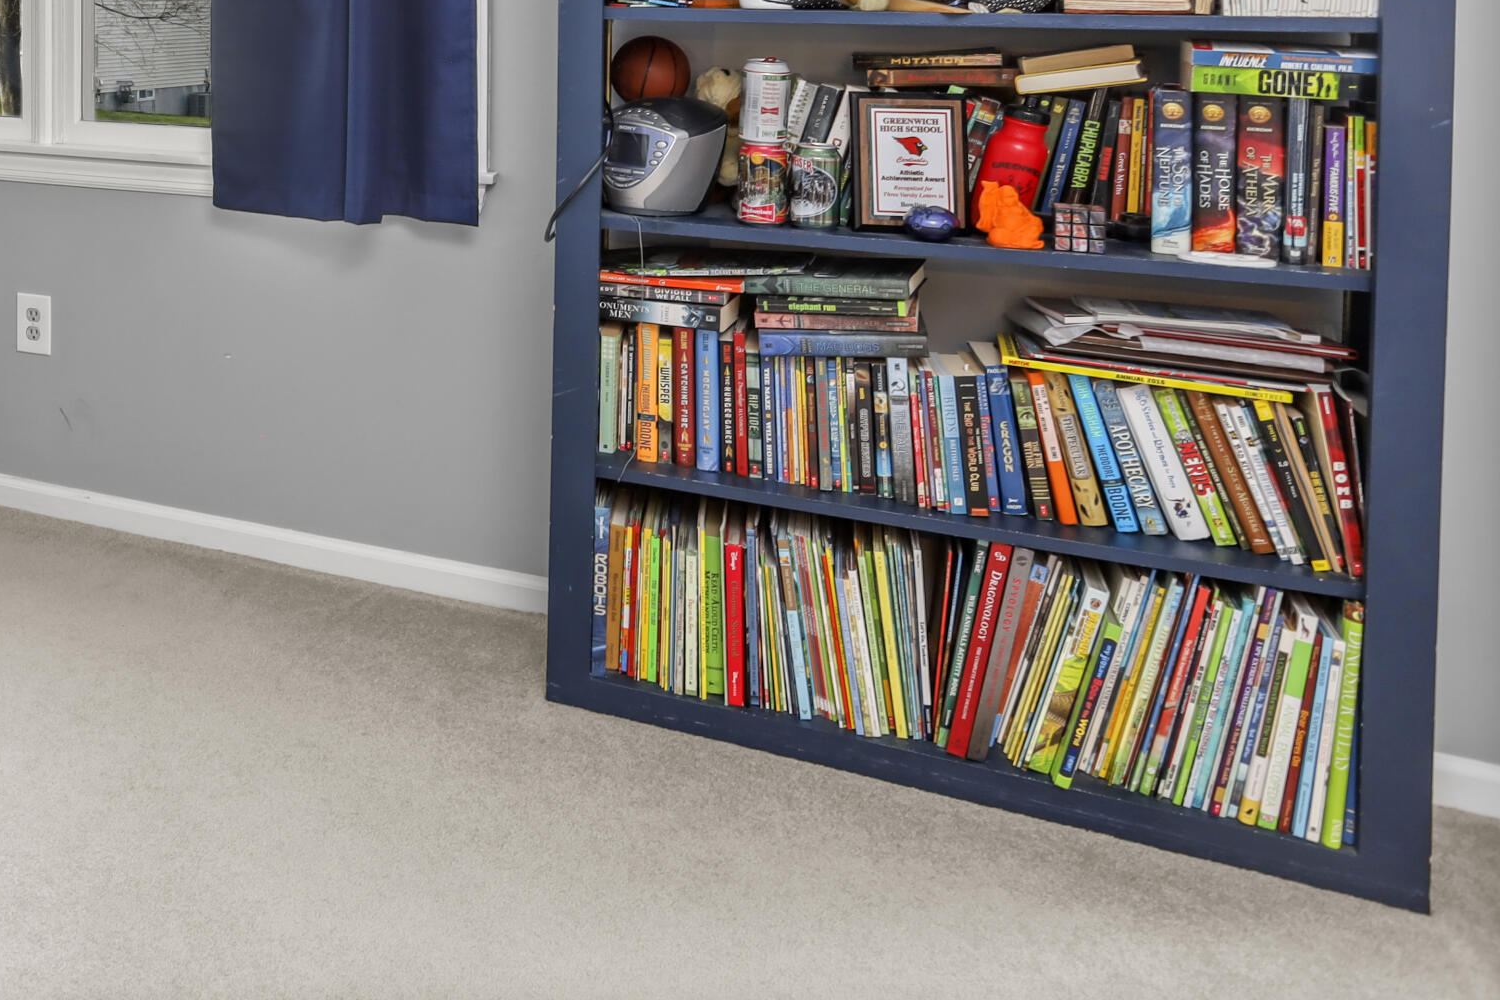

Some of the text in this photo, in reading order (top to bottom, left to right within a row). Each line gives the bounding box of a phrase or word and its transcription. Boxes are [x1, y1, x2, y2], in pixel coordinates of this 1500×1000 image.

[890, 56, 965, 65] MUTATION
[1259, 69, 1314, 96] GONE
[880, 125, 943, 134] HIGH SCHOOL
[882, 117, 939, 126] GREENWICH
[1071, 120, 1100, 189] CHUPACABRA
[1114, 152, 1126, 195] Greek Myths
[1156, 146, 1173, 208] NEPTUNE
[1172, 163, 1191, 196] SON
[1196, 150, 1213, 209] OF HADES
[1214, 151, 1232, 211] THE HOUSE
[1241, 146, 1260, 217] OF ATHENA
[1260, 154, 1280, 215] THE MARK
[654, 288, 692, 296] DIVIDED
[797, 281, 820, 292] THE
[824, 282, 876, 294] GENERAL
[600, 301, 651, 313] ONUMENTS
[609, 309, 632, 319] MEN
[788, 303, 821, 311] elephant
[659, 367, 669, 403] WHISPER
[679, 364, 688, 404] CATCHING
[702, 370, 710, 429] MOCKINGJAY
[680, 409, 688, 427] FIRE
[748, 394, 758, 430] RIP TIDE
[964, 413, 973, 426] END
[640, 422, 651, 449] BOONE
[966, 447, 977, 471] WORLD
[1067, 435, 1086, 474] PECULIAR
[1109, 422, 1154, 512] APOTHECARY
[1153, 438, 1170, 467] Rhymes
[1177, 439, 1214, 498] NERDS
[969, 472, 980, 491] CLUB
[1096, 443, 1115, 479] THEODORE
[1108, 486, 1130, 521] BOONE
[1331, 460, 1353, 509] BOMB
[1236, 490, 1261, 532] MONSTERS
[593, 554, 606, 614] ROBOTS
[965, 594, 975, 611] WILD
[976, 571, 1001, 641] DRAGONOLOGY
[1002, 578, 1020, 631] SPYOLOGY
[958, 614, 972, 646] ANIMALS
[1334, 631, 1362, 770] DINOSAUR ATLAS
[1071, 718, 1088, 746] World
[1298, 709, 1308, 728] Bear
[1198, 721, 1212, 754] Christmas
[1293, 729, 1305, 754] Snores
